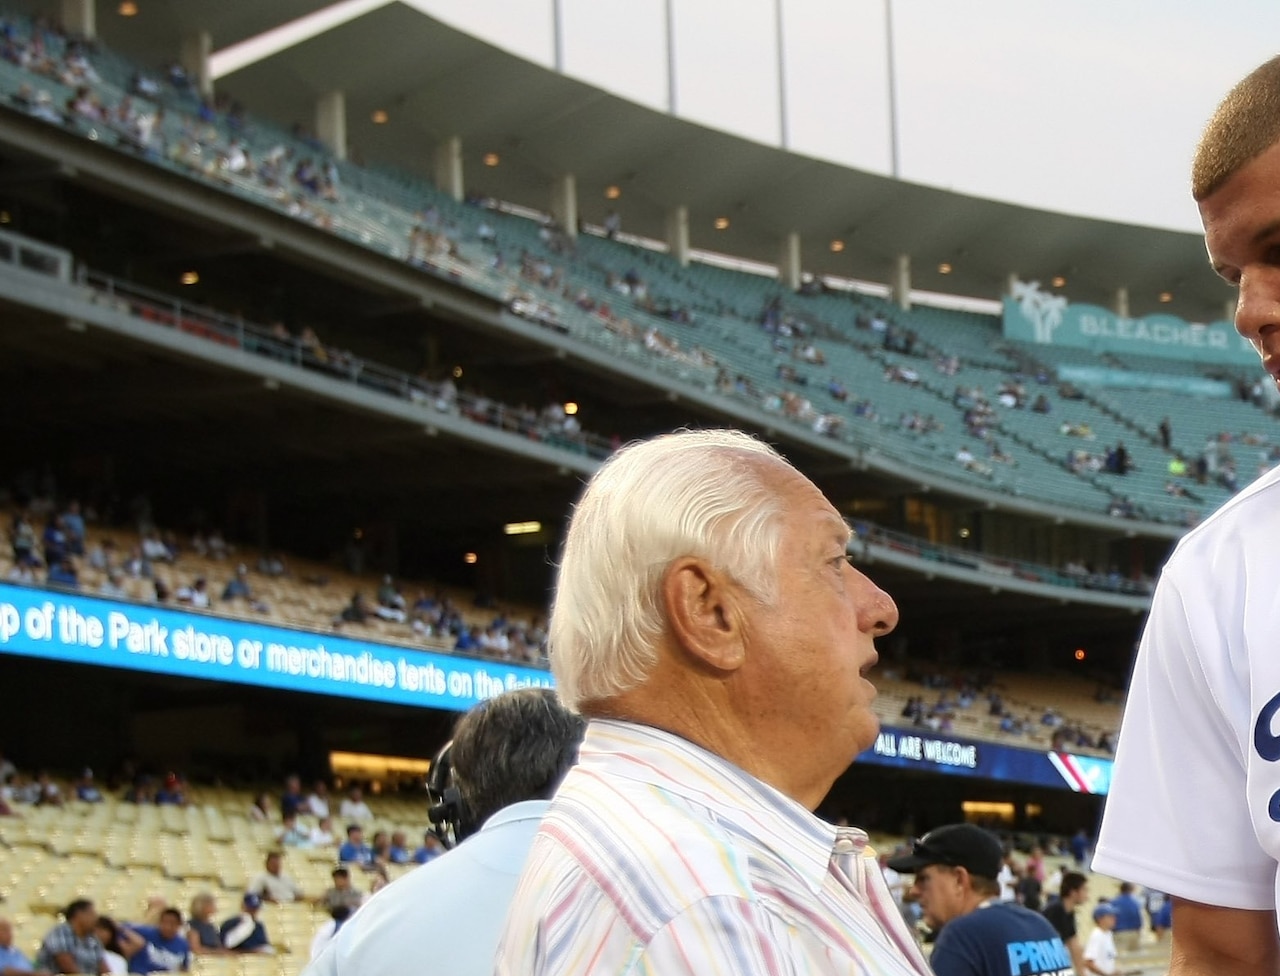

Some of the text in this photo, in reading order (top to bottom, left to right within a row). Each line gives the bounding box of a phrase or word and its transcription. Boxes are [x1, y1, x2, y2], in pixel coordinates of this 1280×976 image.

[1079, 314, 1229, 349] BLEACHER
[24, 600, 56, 641] of
[58, 604, 104, 648] the
[107, 611, 169, 657] Park
[171, 624, 234, 666] store
[236, 639, 262, 669] or
[266, 643, 396, 688] merchandise
[398, 657, 446, 695] tents
[449, 671, 473, 698] on
[473, 669, 504, 700] the
[874, 733, 977, 768] ALL ARE WELCOME
